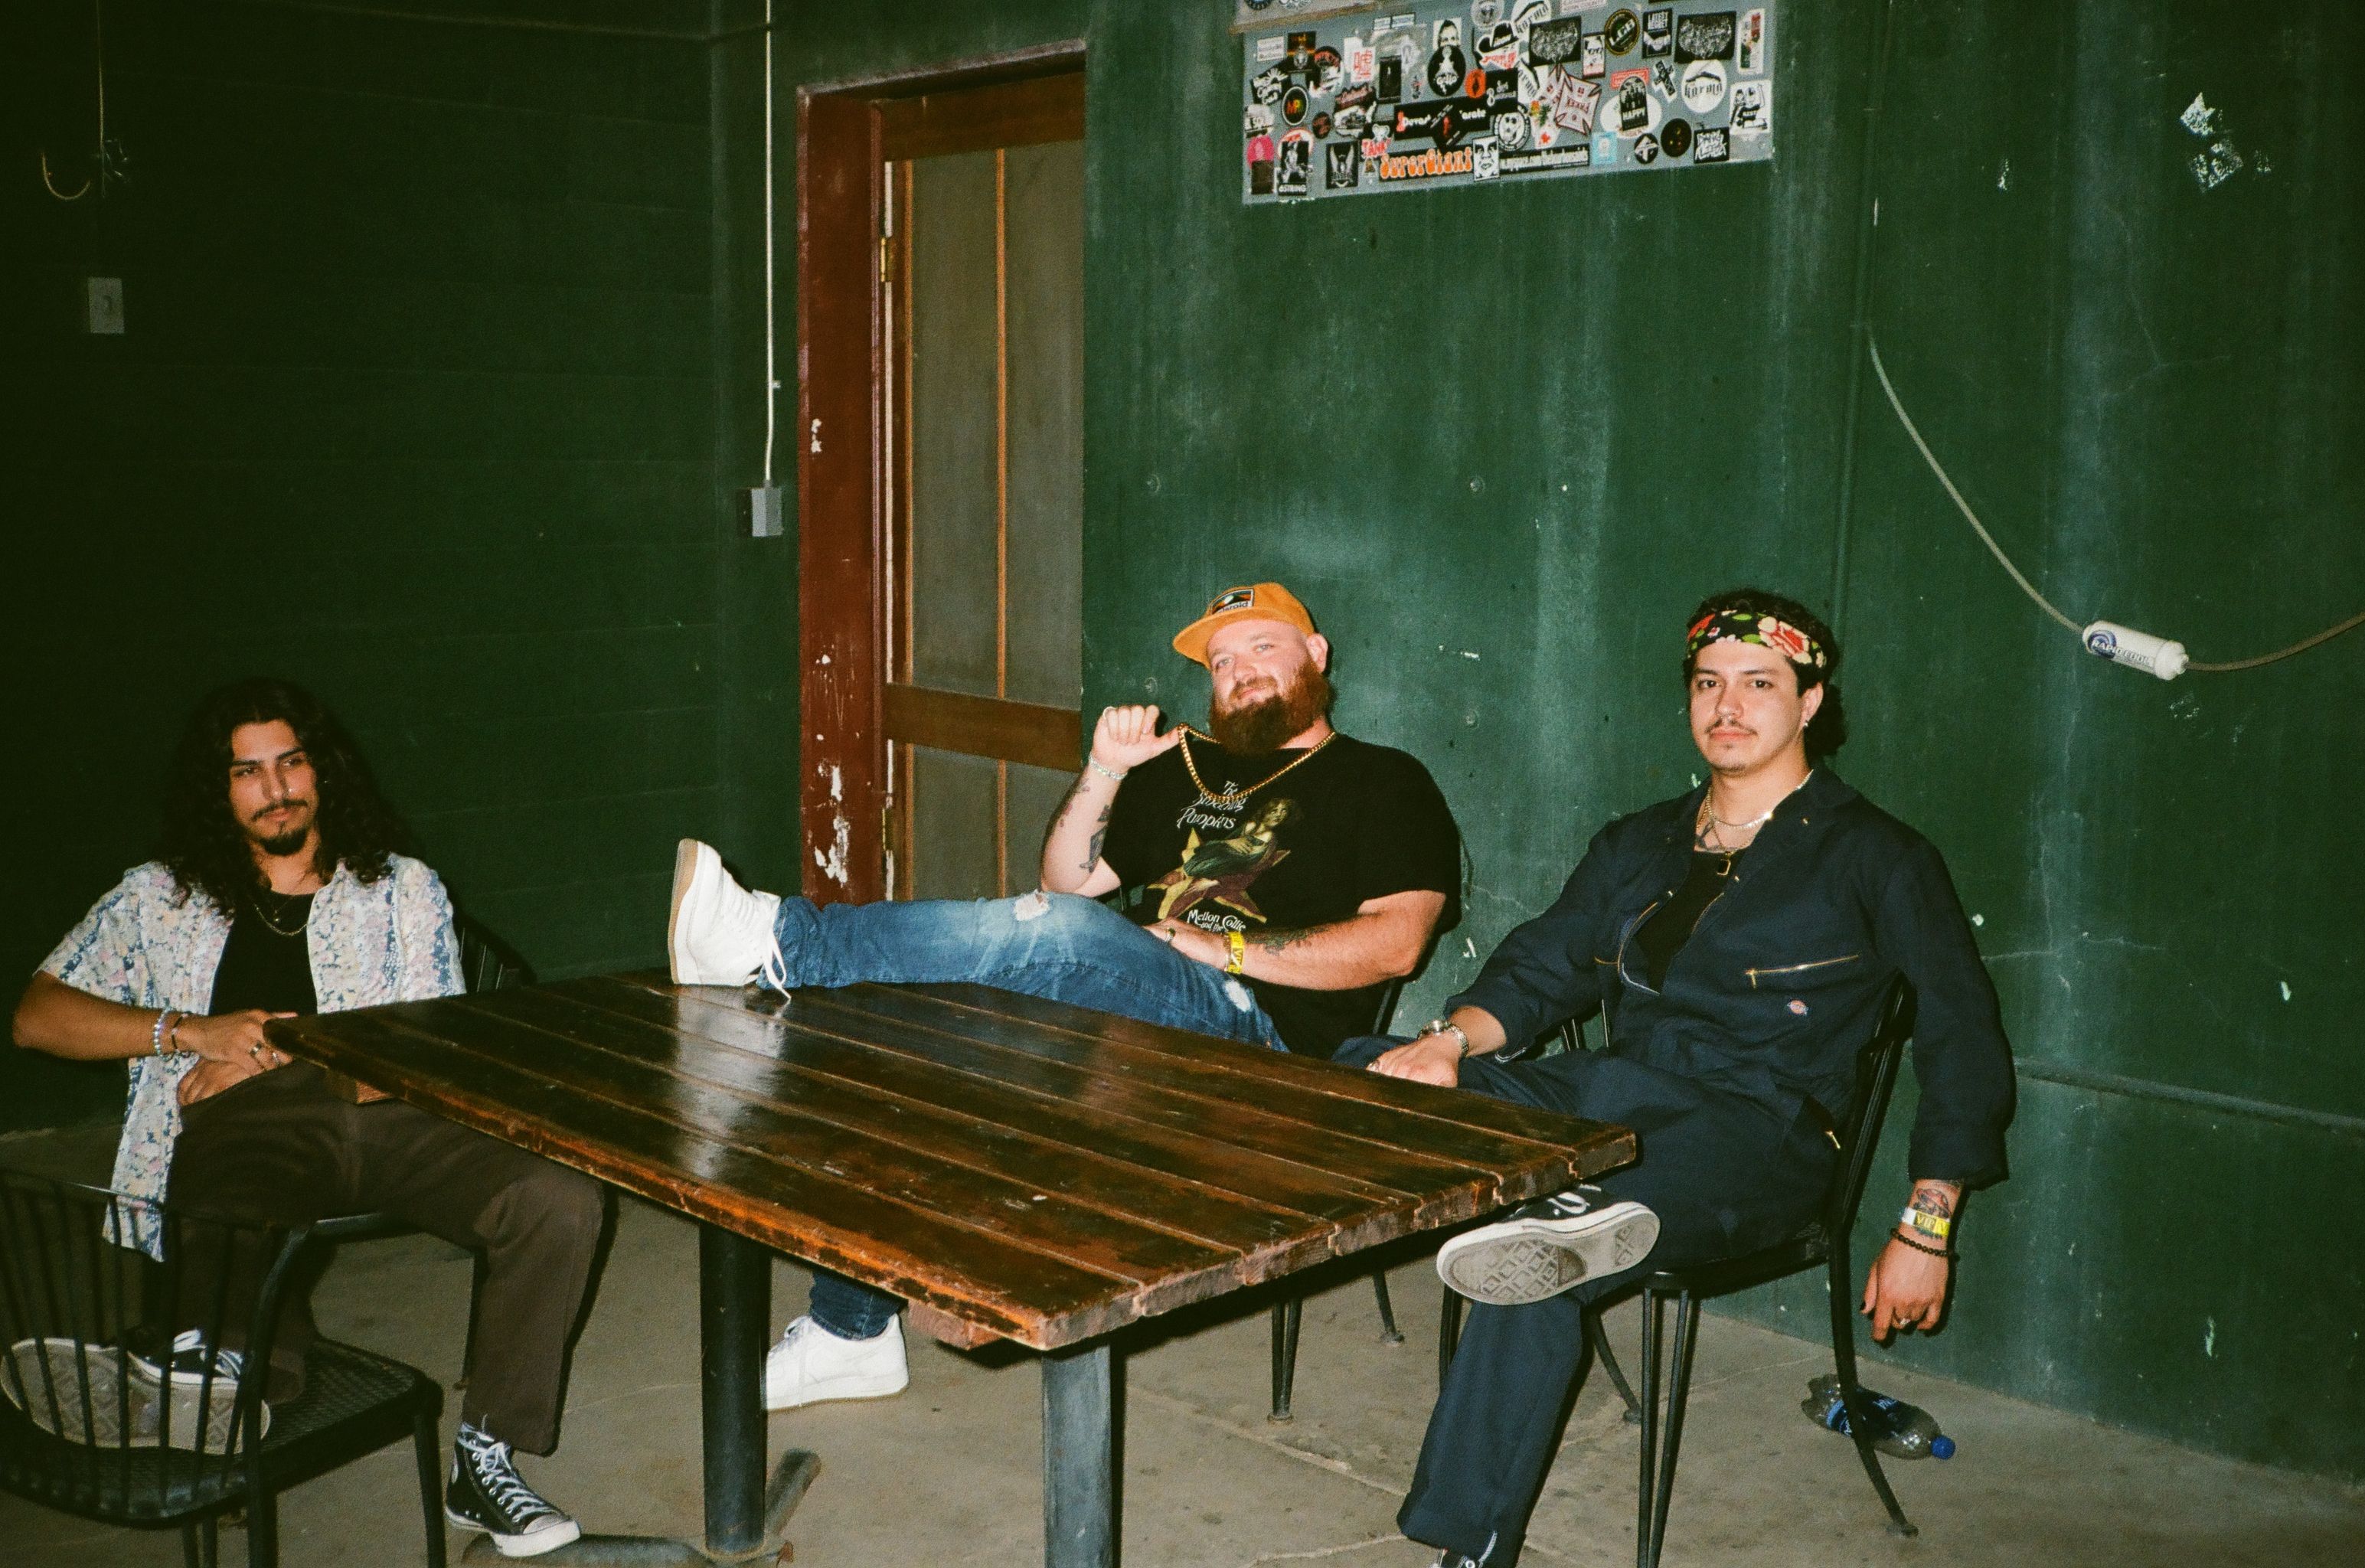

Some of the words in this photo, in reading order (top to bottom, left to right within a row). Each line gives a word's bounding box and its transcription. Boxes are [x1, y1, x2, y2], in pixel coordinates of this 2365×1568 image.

[1684, 83, 1723, 99] karma
[1622, 108, 1645, 121] HAPPY
[1223, 780, 1239, 796] The
[1176, 807, 1236, 830] Pumpkins
[1187, 908, 1220, 926] Mellon
[1222, 914, 1246, 933] Collie
[1200, 921, 1214, 930] and
[1916, 1211, 1937, 1232] VIP
